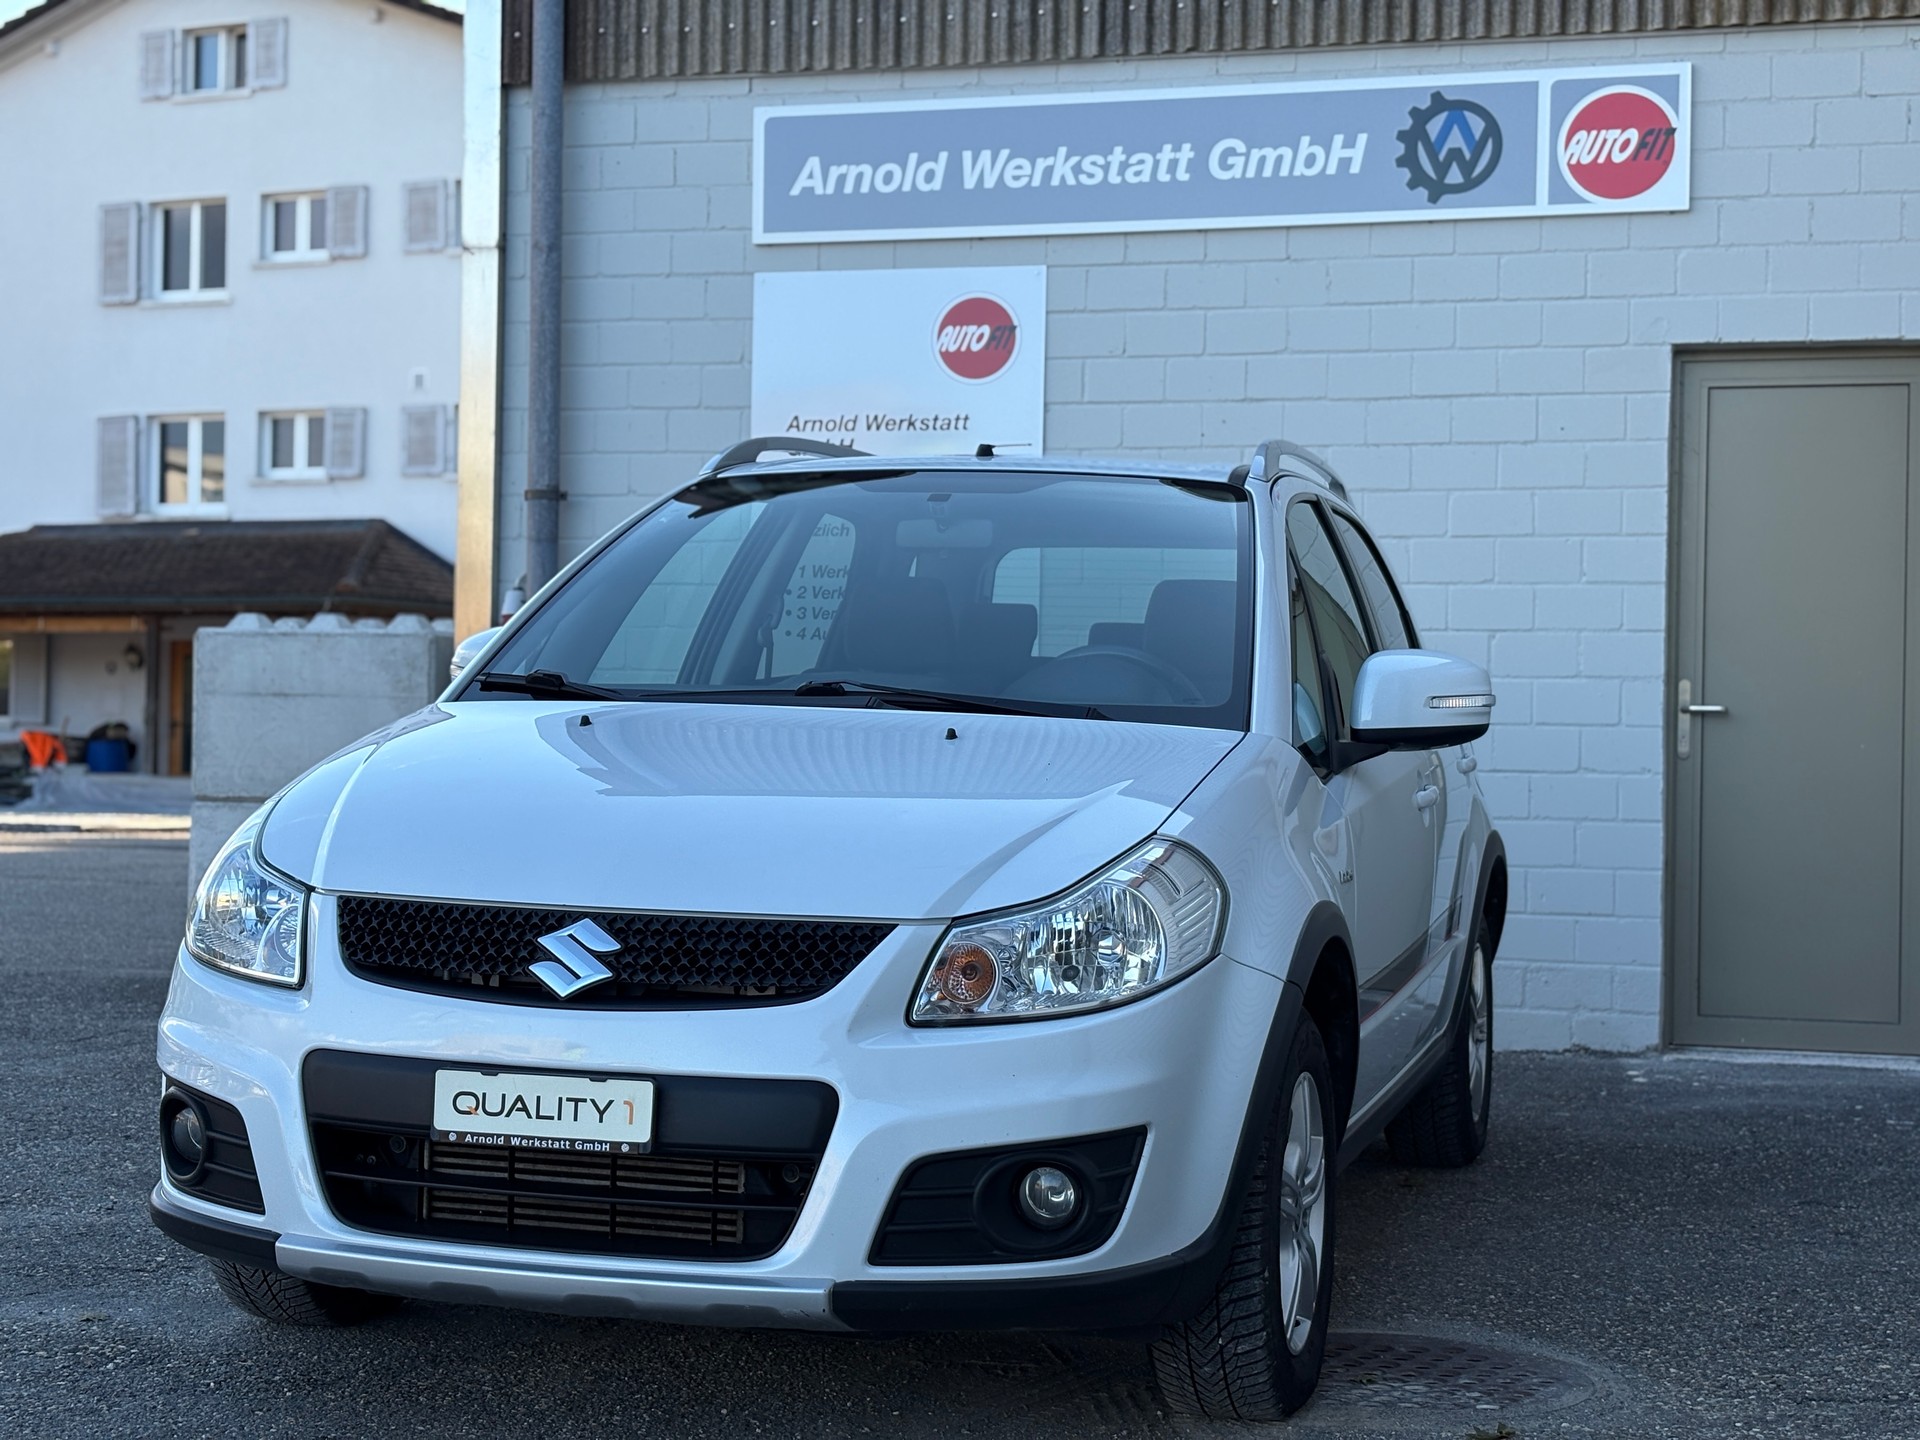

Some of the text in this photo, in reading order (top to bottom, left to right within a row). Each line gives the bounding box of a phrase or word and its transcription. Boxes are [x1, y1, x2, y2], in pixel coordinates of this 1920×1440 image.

[789, 133, 1367, 196] Arnold Werkstatt GmbH
[786, 413, 970, 432] Arnold Werkstatt
[797, 586, 807, 599] 2
[796, 607, 807, 620] 3
[796, 627, 807, 640] 4
[465, 1133, 610, 1152] Arnold Werkstatt GmbH
